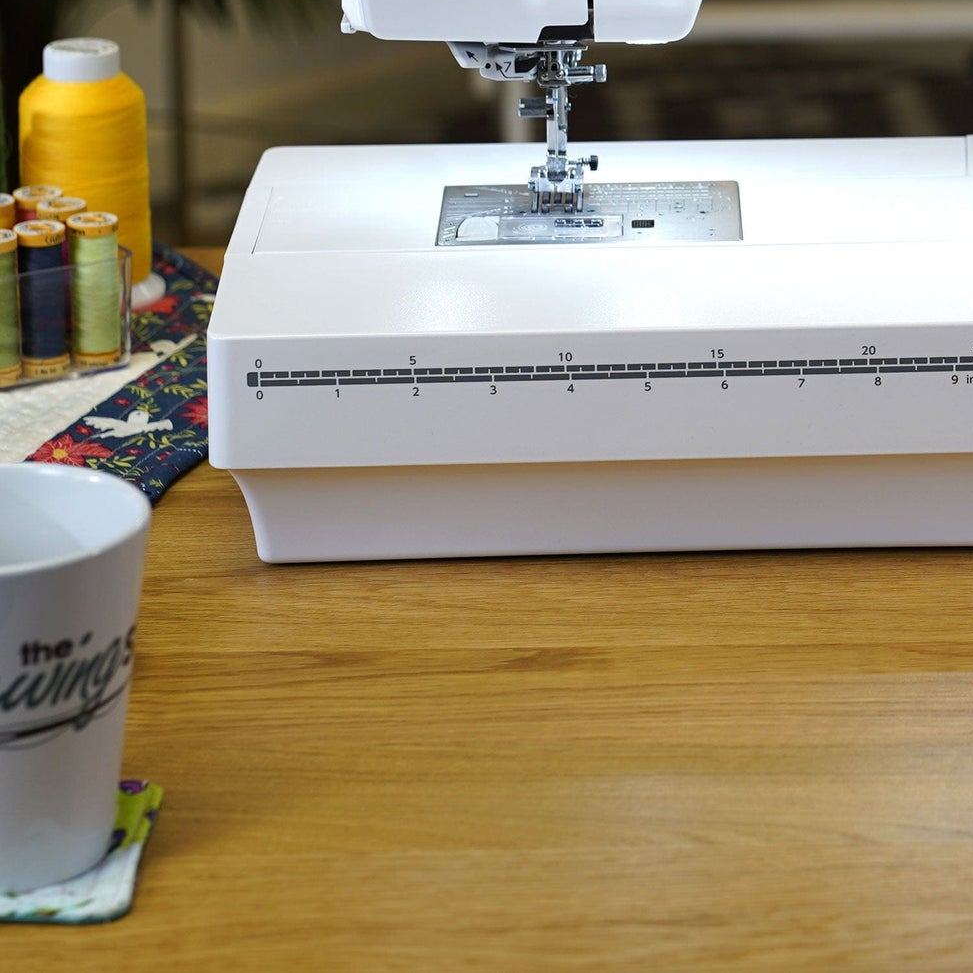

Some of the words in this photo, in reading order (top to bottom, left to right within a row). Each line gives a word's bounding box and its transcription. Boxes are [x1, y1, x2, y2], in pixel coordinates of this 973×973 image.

[503, 61, 512, 73] 7
[255, 358, 262, 368] 0
[409, 355, 417, 365] 5
[558, 352, 573, 362] 10
[710, 349, 725, 359] 15
[861, 345, 876, 355] 20
[256, 390, 263, 400] 0
[335, 388, 340, 398] 1
[412, 387, 420, 397] 2
[490, 385, 497, 395] 3
[566, 384, 575, 394] 4
[644, 382, 652, 391] 5
[721, 380, 729, 390] 6
[798, 379, 806, 388] 7
[874, 377, 882, 386] 8
[951, 375, 959, 385] 9
[21, 639, 74, 666] the
